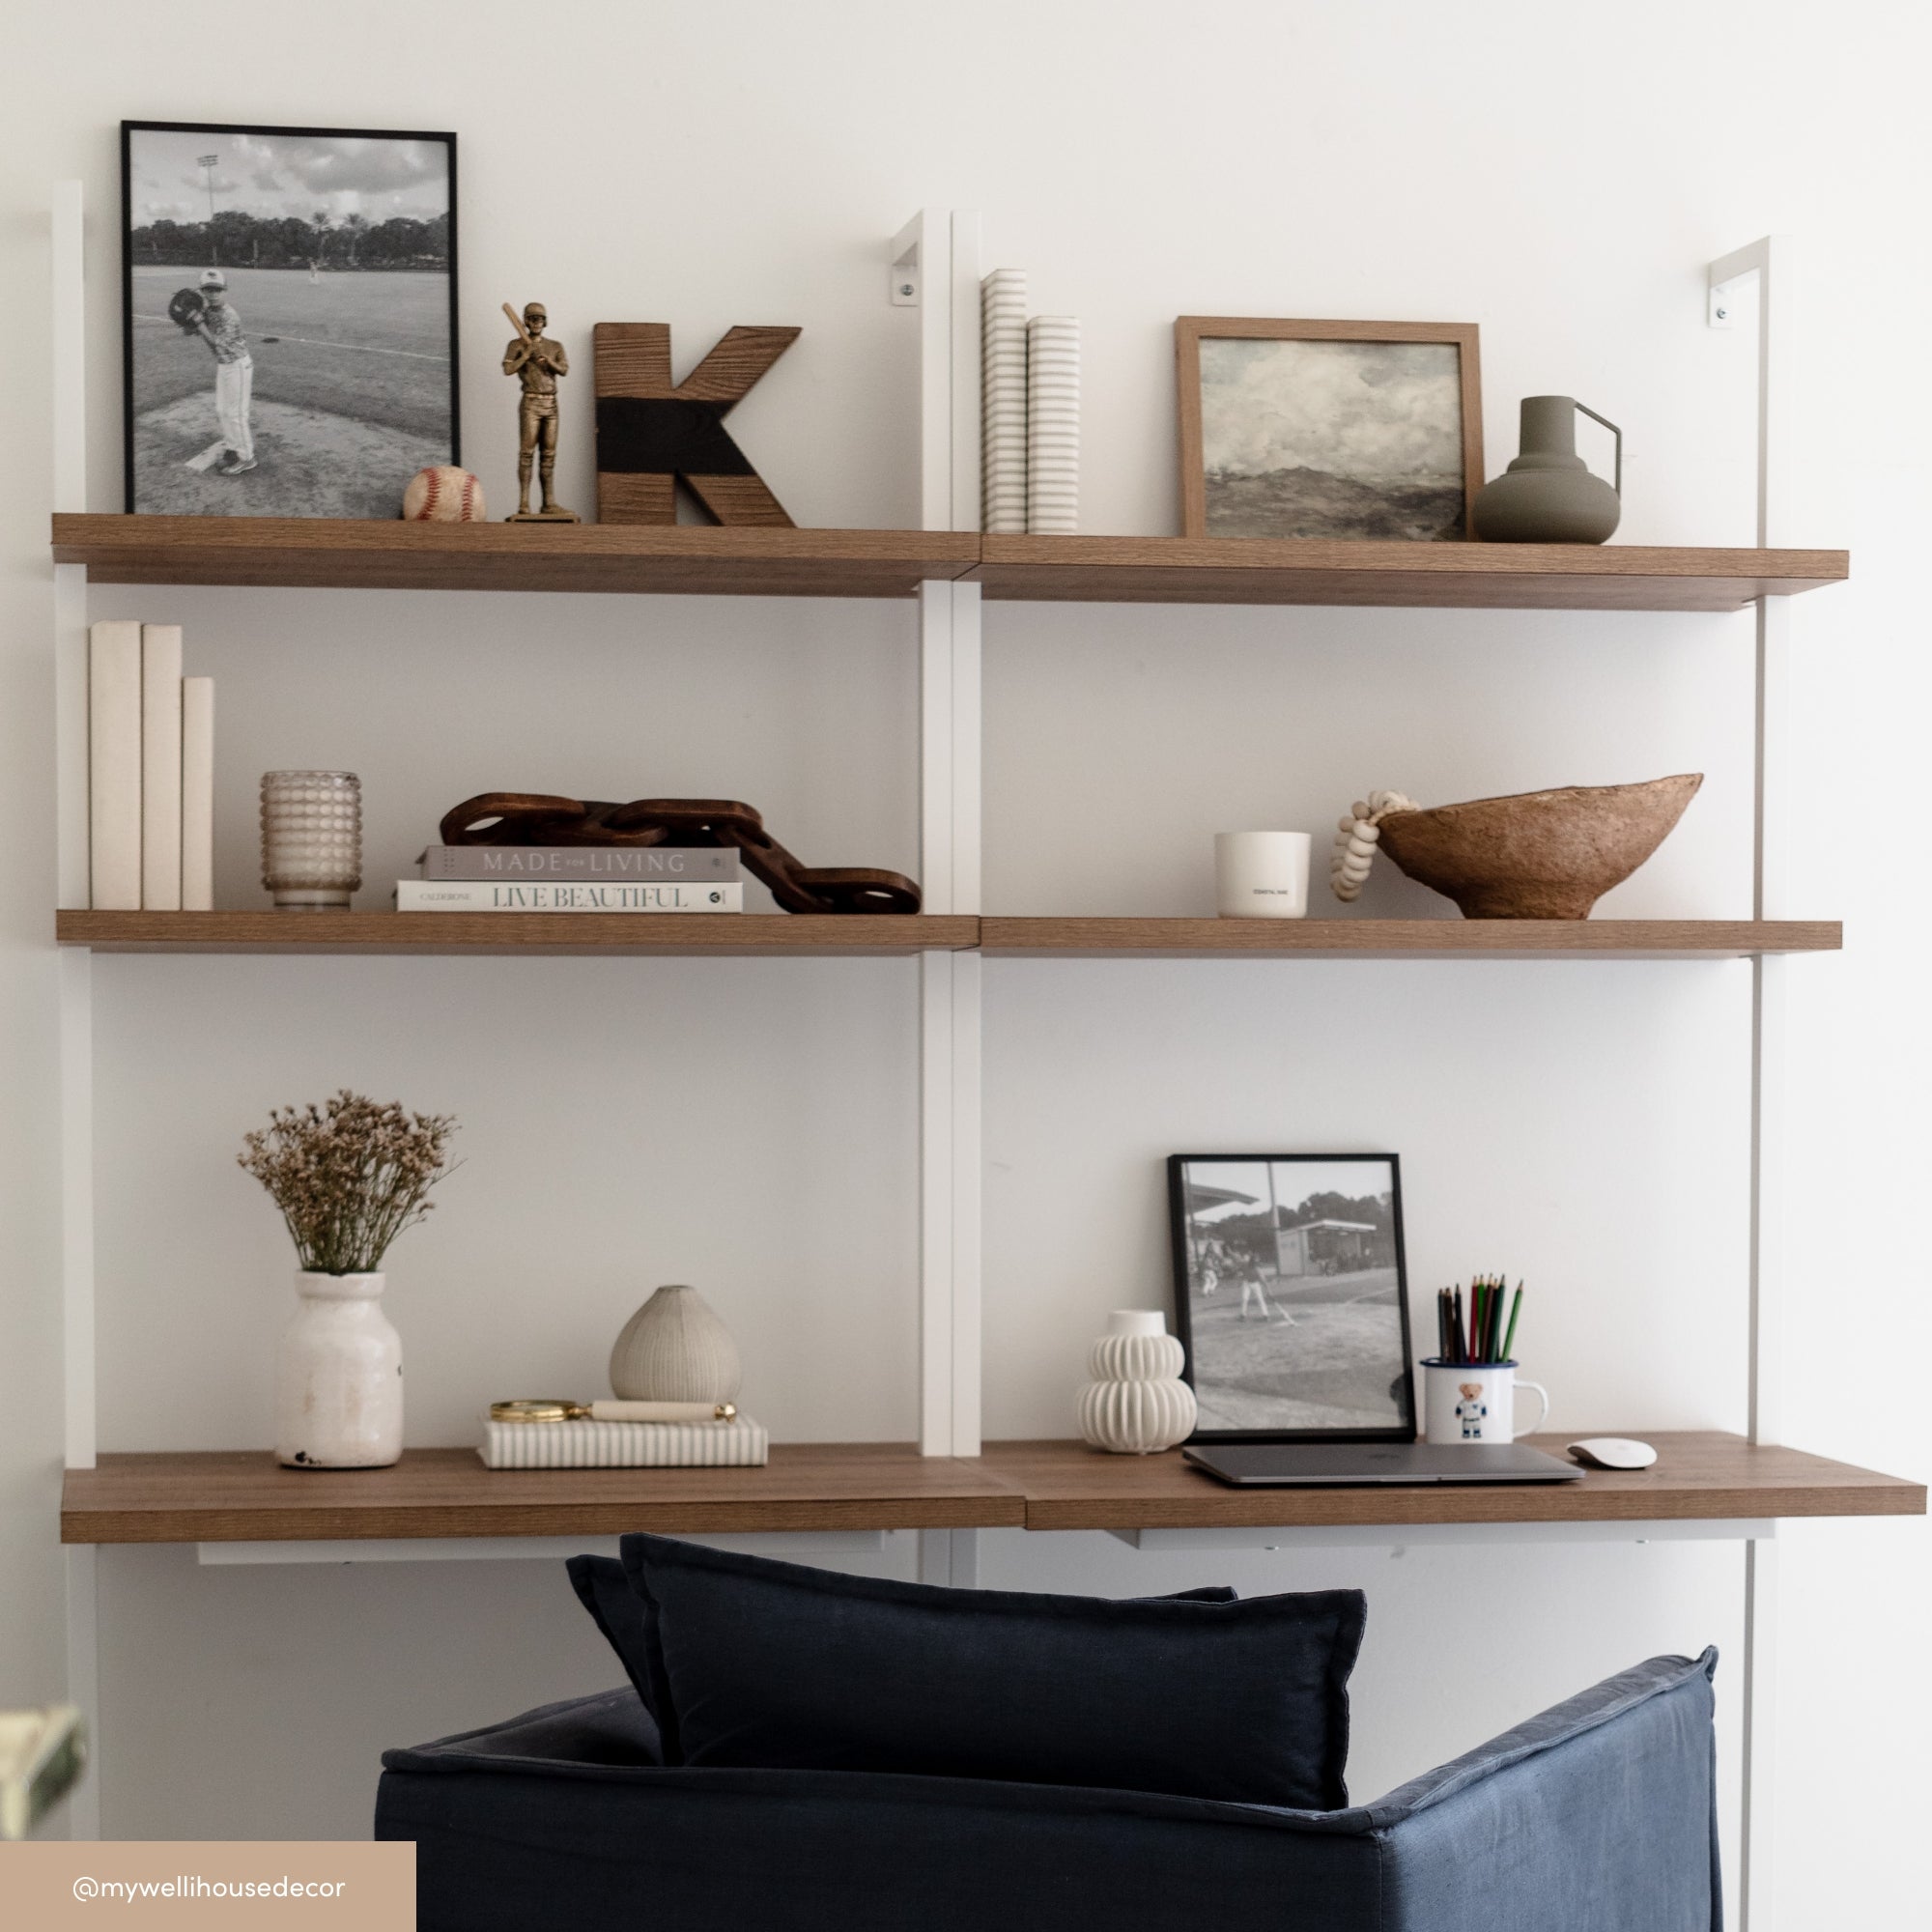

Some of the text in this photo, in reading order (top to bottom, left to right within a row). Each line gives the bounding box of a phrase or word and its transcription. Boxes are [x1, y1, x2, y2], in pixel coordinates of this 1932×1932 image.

[593, 322, 802, 528] K
[483, 852, 562, 871] MADE
[589, 852, 685, 872] LIVING
[494, 887, 689, 908] LIVE BEAUTIFUL
